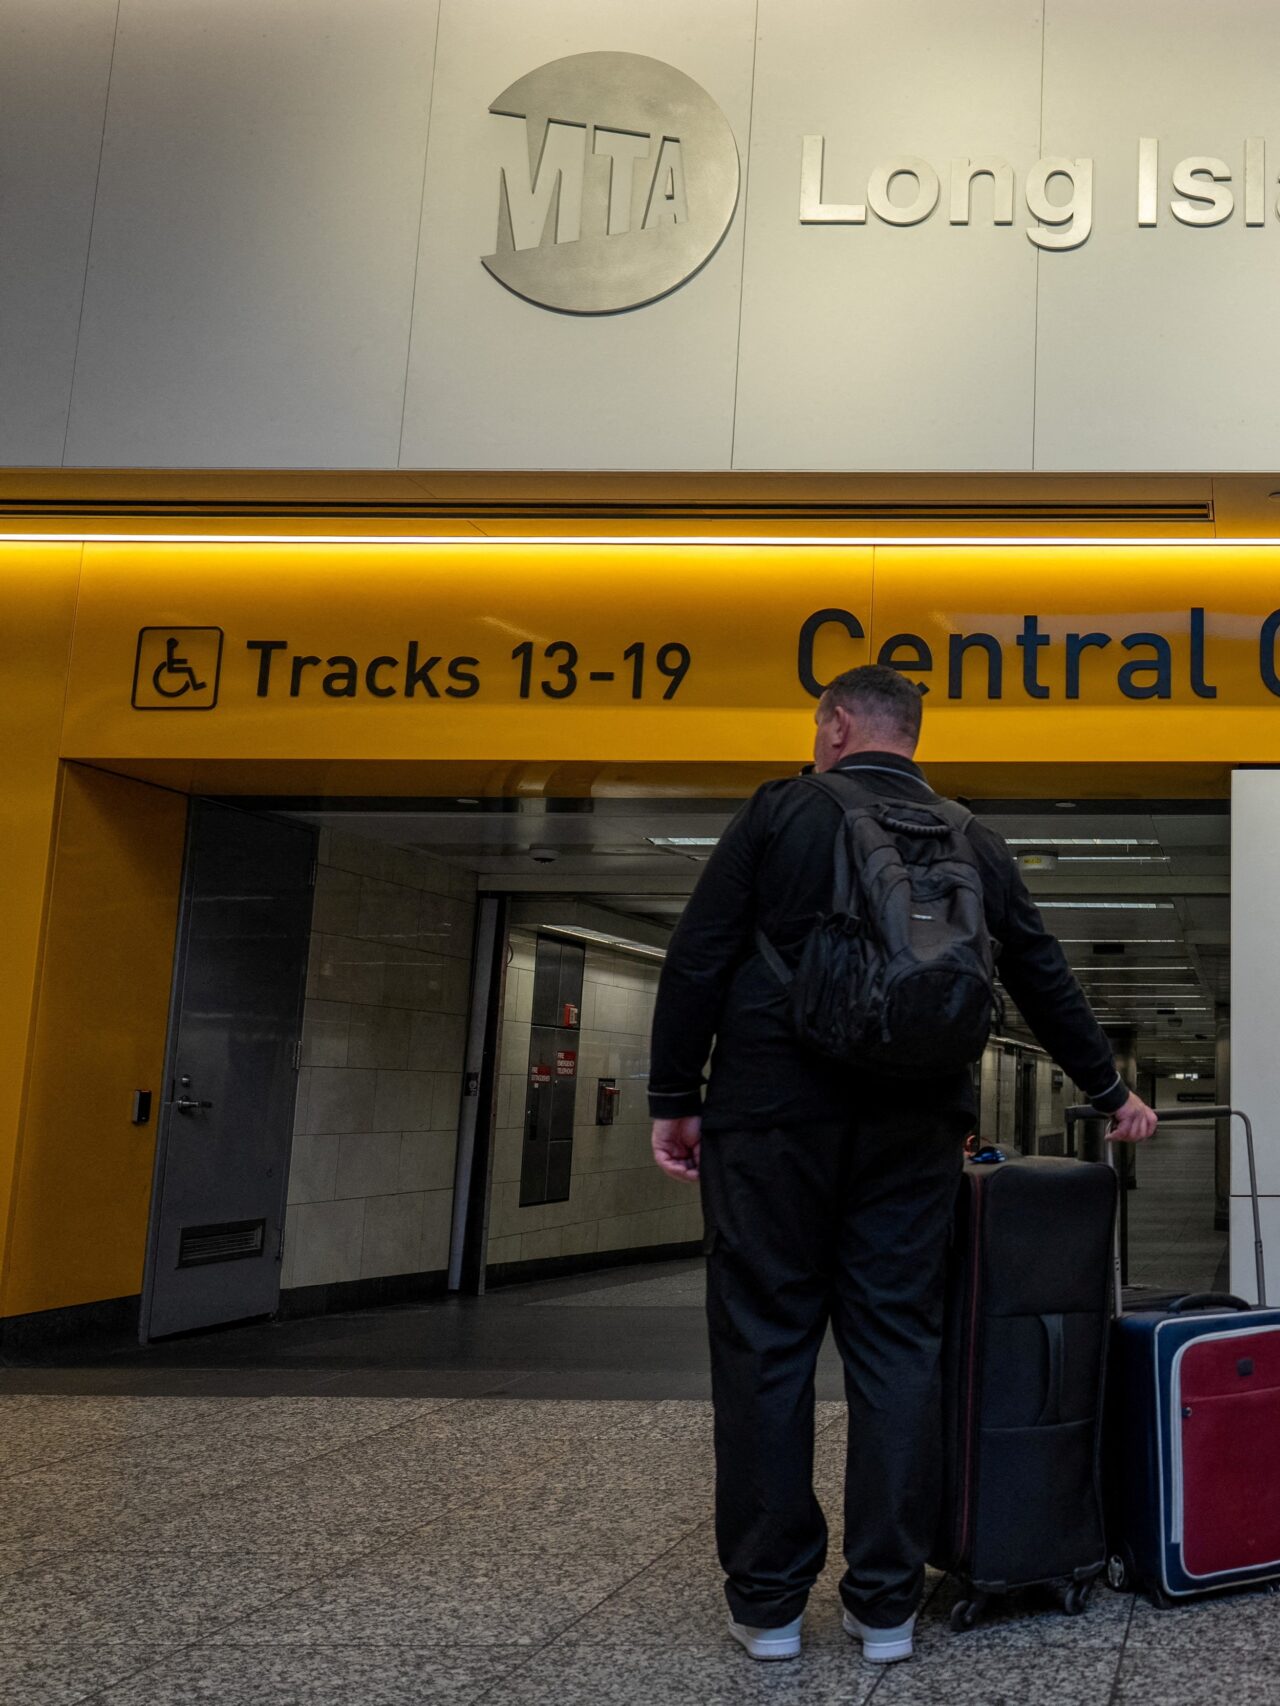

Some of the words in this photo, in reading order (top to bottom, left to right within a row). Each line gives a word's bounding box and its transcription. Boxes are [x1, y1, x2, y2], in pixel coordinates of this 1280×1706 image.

[489, 111, 689, 253] MTA
[799, 134, 1094, 251] Long
[246, 639, 482, 699] Tracks
[510, 640, 693, 700] 13-19
[797, 607, 1218, 700] Central
